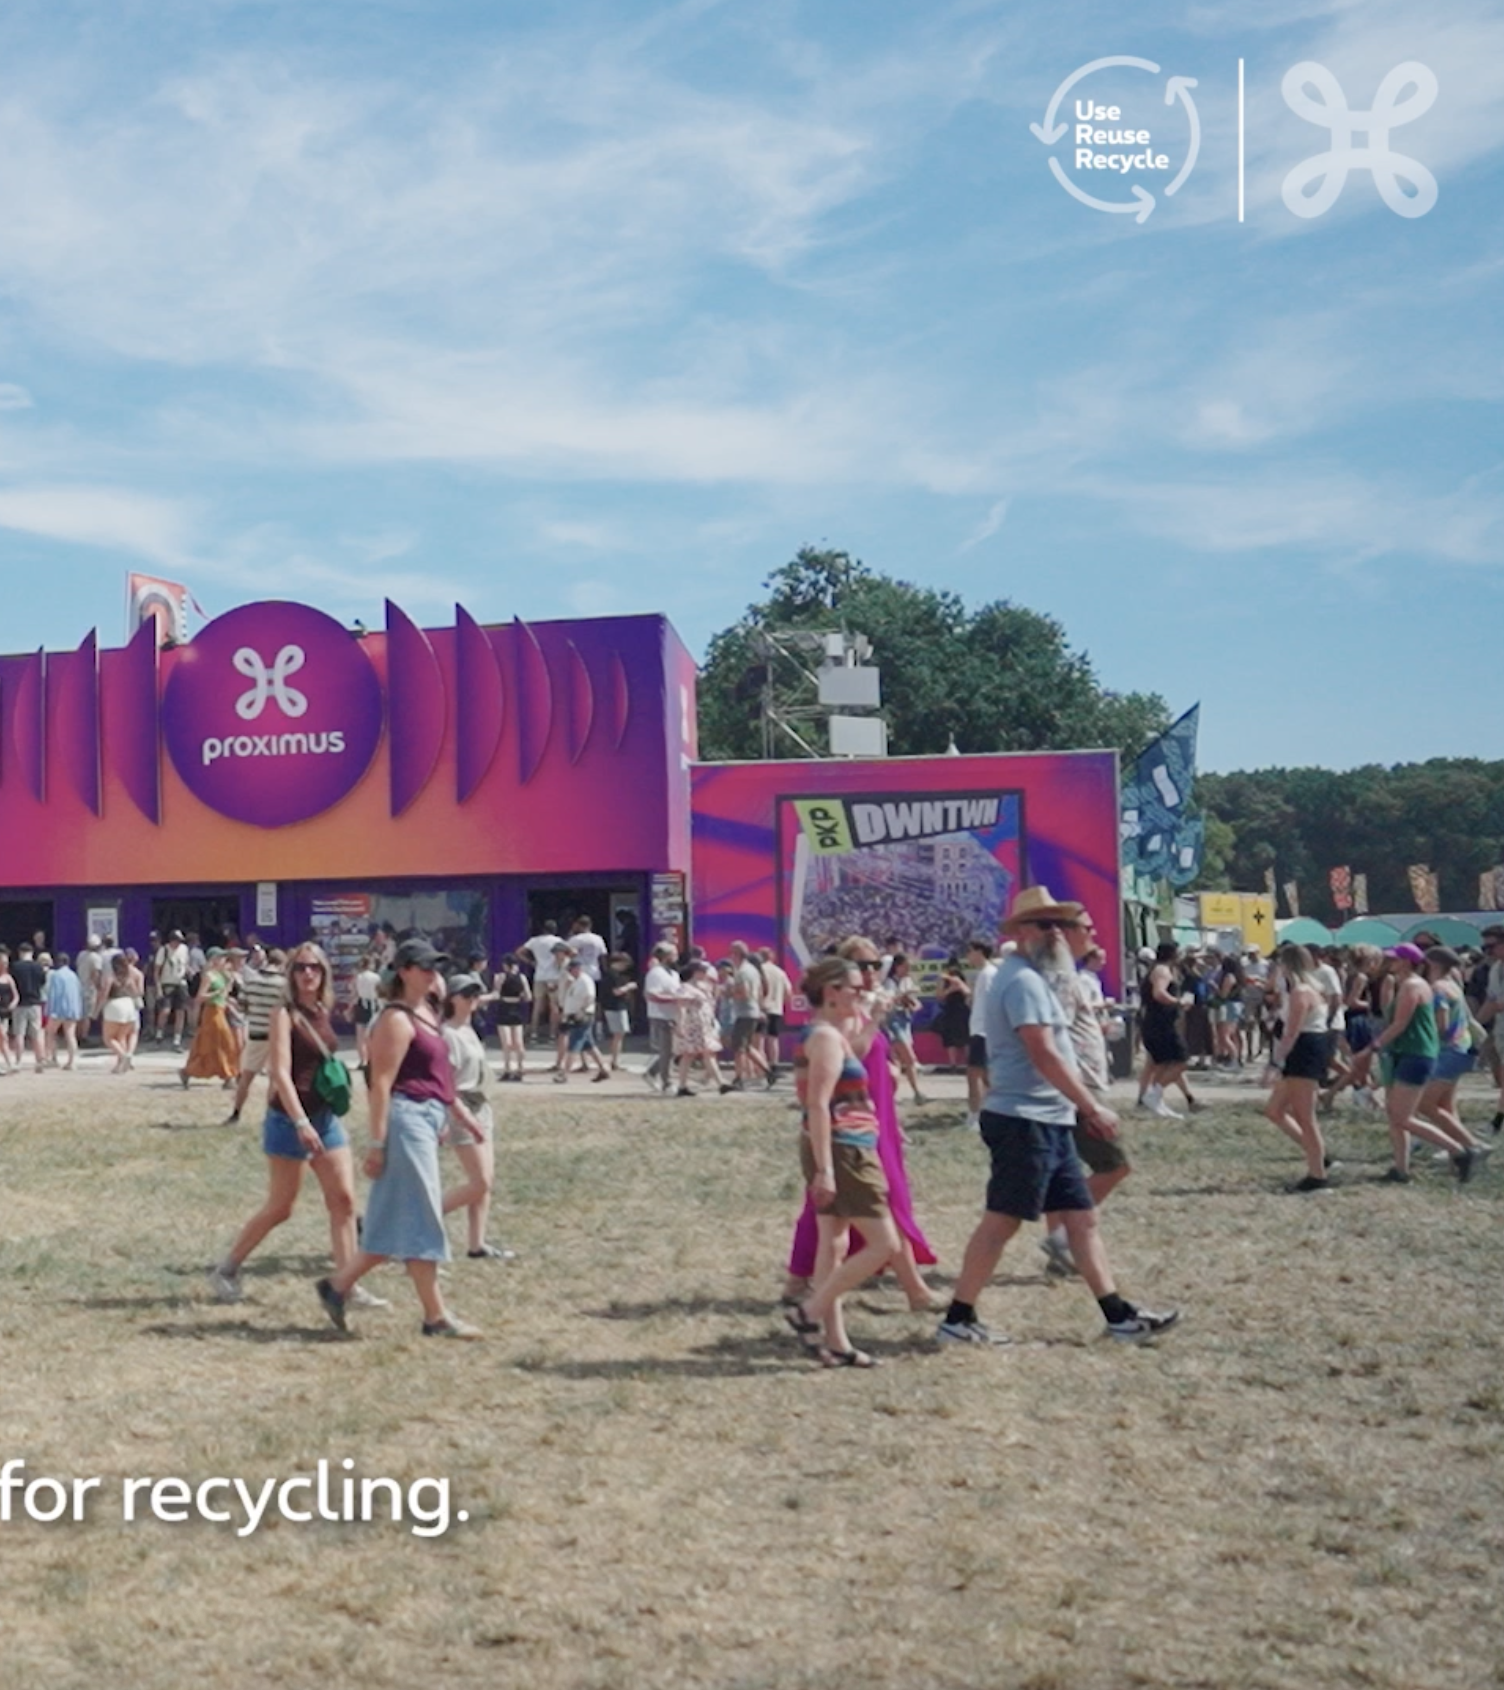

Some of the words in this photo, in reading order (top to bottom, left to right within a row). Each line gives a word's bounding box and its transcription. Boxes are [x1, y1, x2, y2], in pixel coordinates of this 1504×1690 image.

[202, 731, 346, 766] proximus
[808, 806, 843, 849] PKP
[851, 798, 999, 844] DWNTWN
